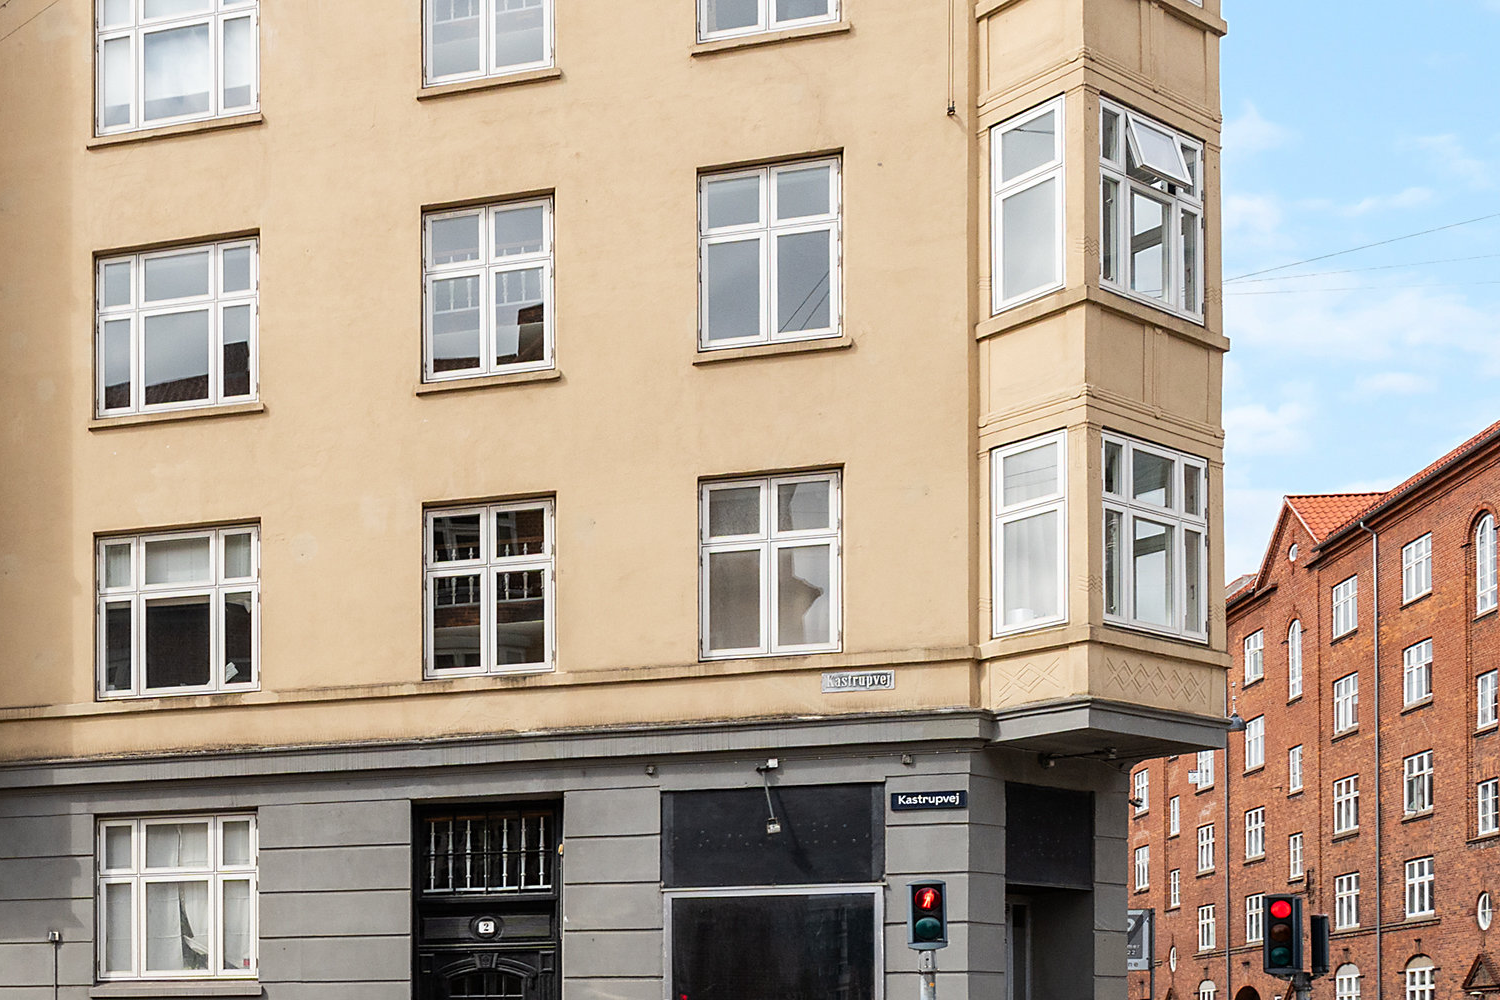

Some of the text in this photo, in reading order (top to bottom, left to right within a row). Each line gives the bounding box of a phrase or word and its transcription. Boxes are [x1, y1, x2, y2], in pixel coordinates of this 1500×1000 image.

[826, 674, 891, 689] Kastrupvej
[898, 793, 960, 805] Kastrupvej
[483, 923, 489, 931] 2
